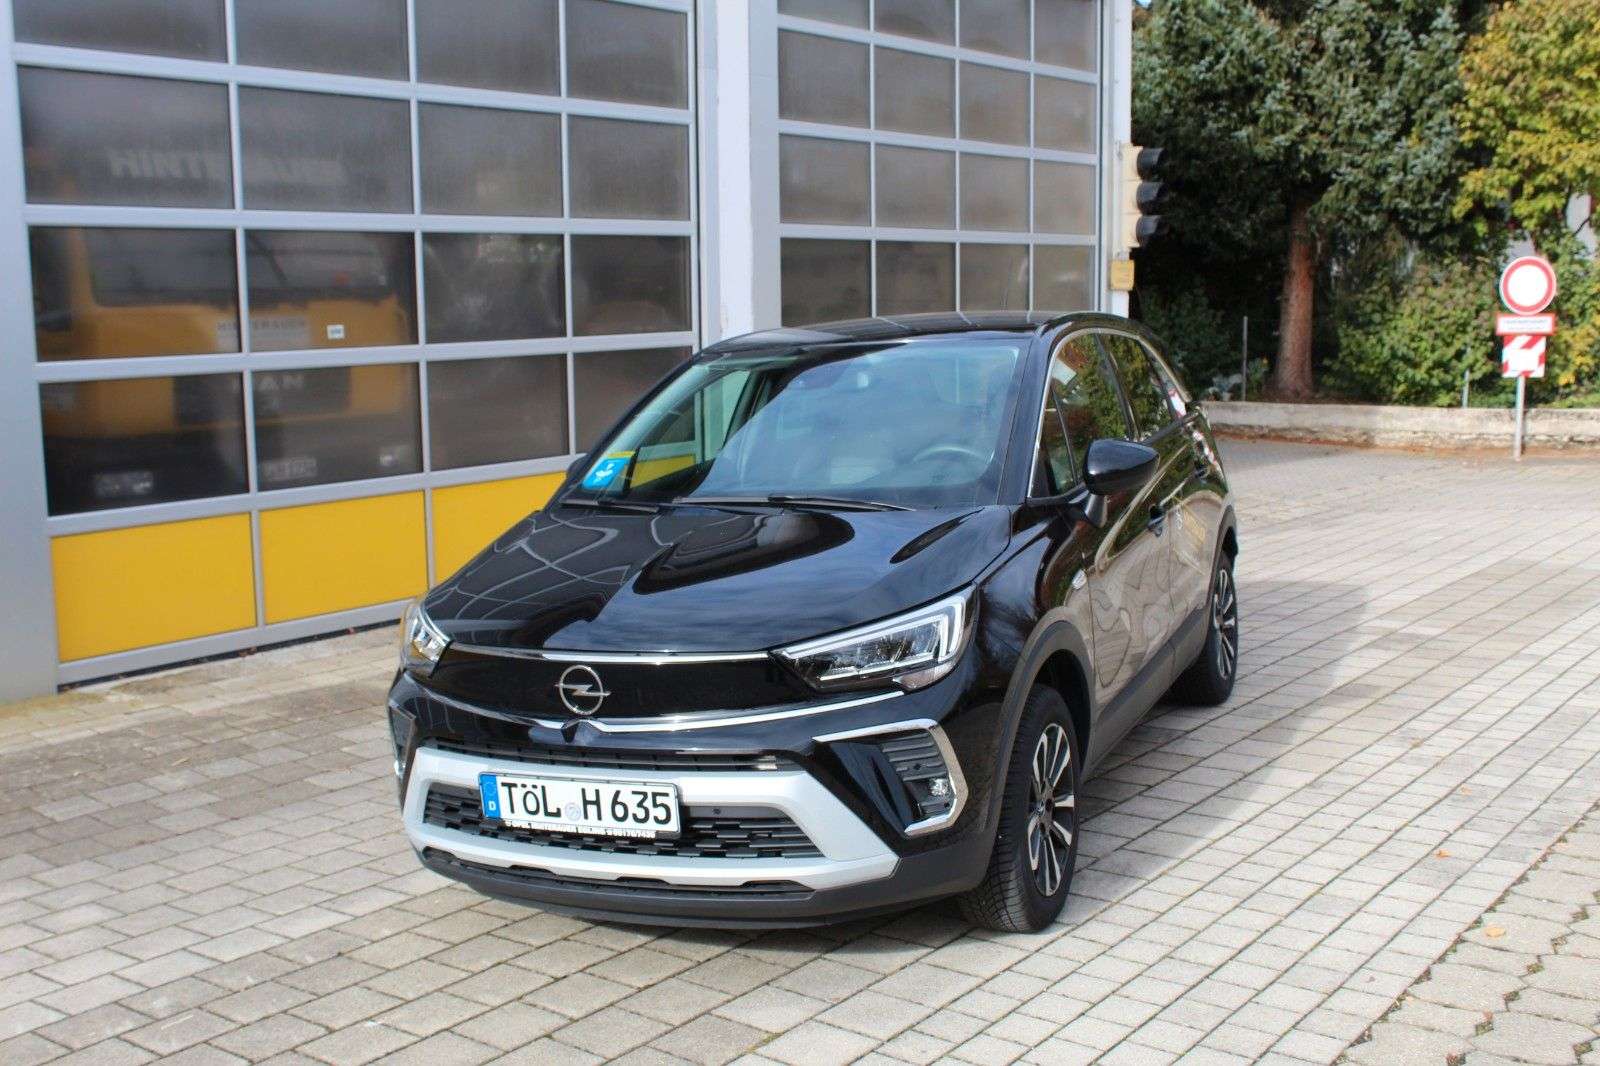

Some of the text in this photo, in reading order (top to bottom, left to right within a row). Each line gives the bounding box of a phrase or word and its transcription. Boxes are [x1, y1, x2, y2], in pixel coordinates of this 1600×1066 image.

[488, 801, 496, 811] D
[501, 782, 672, 825] TÖL H 635
